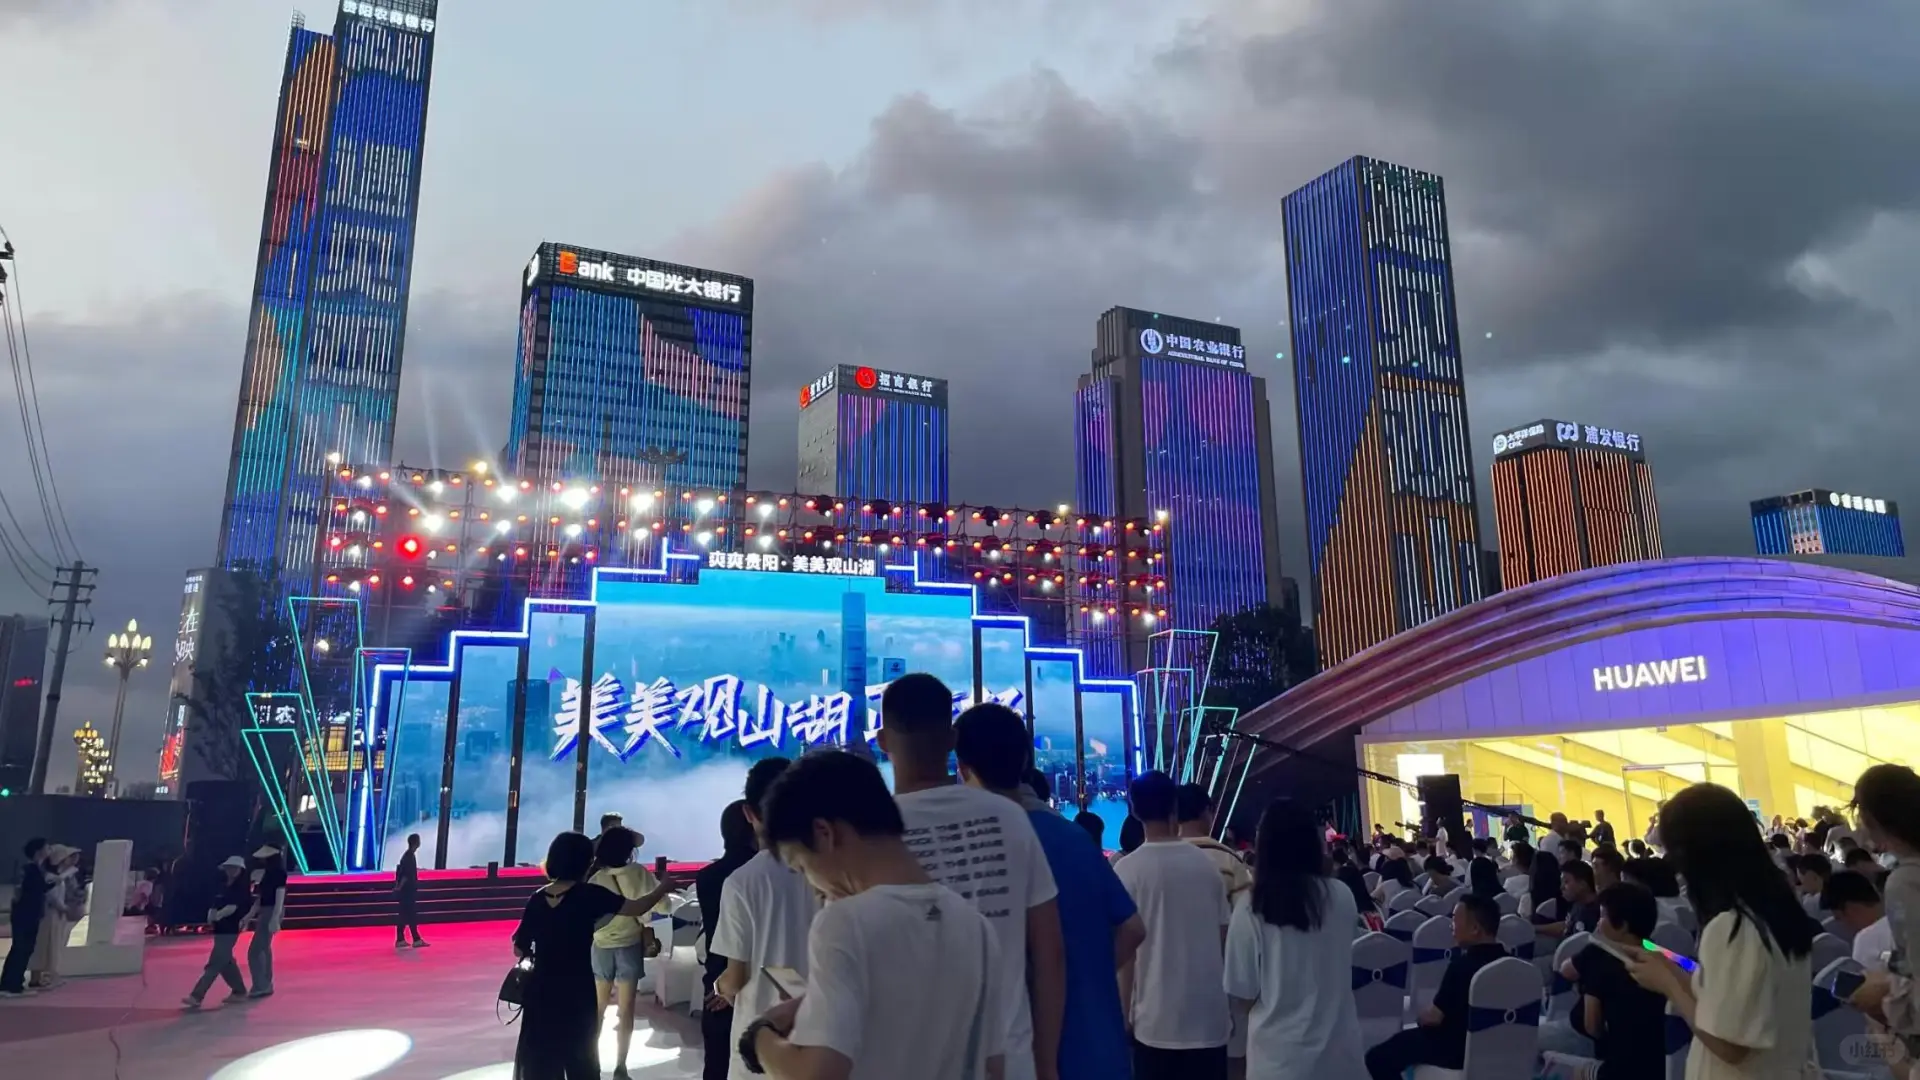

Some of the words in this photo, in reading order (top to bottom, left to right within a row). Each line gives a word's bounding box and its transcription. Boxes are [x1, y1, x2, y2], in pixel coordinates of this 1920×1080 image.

[627, 268, 741, 302] 中国光大银行
[1166, 333, 1244, 359] 中国农业银行
[879, 372, 933, 392] 招商银行
[1507, 424, 1545, 441] 太平洋保险
[1584, 425, 1640, 451] 浦发银行
[1593, 655, 1707, 691] HUAWEI
[979, 908, 1010, 917] AME
